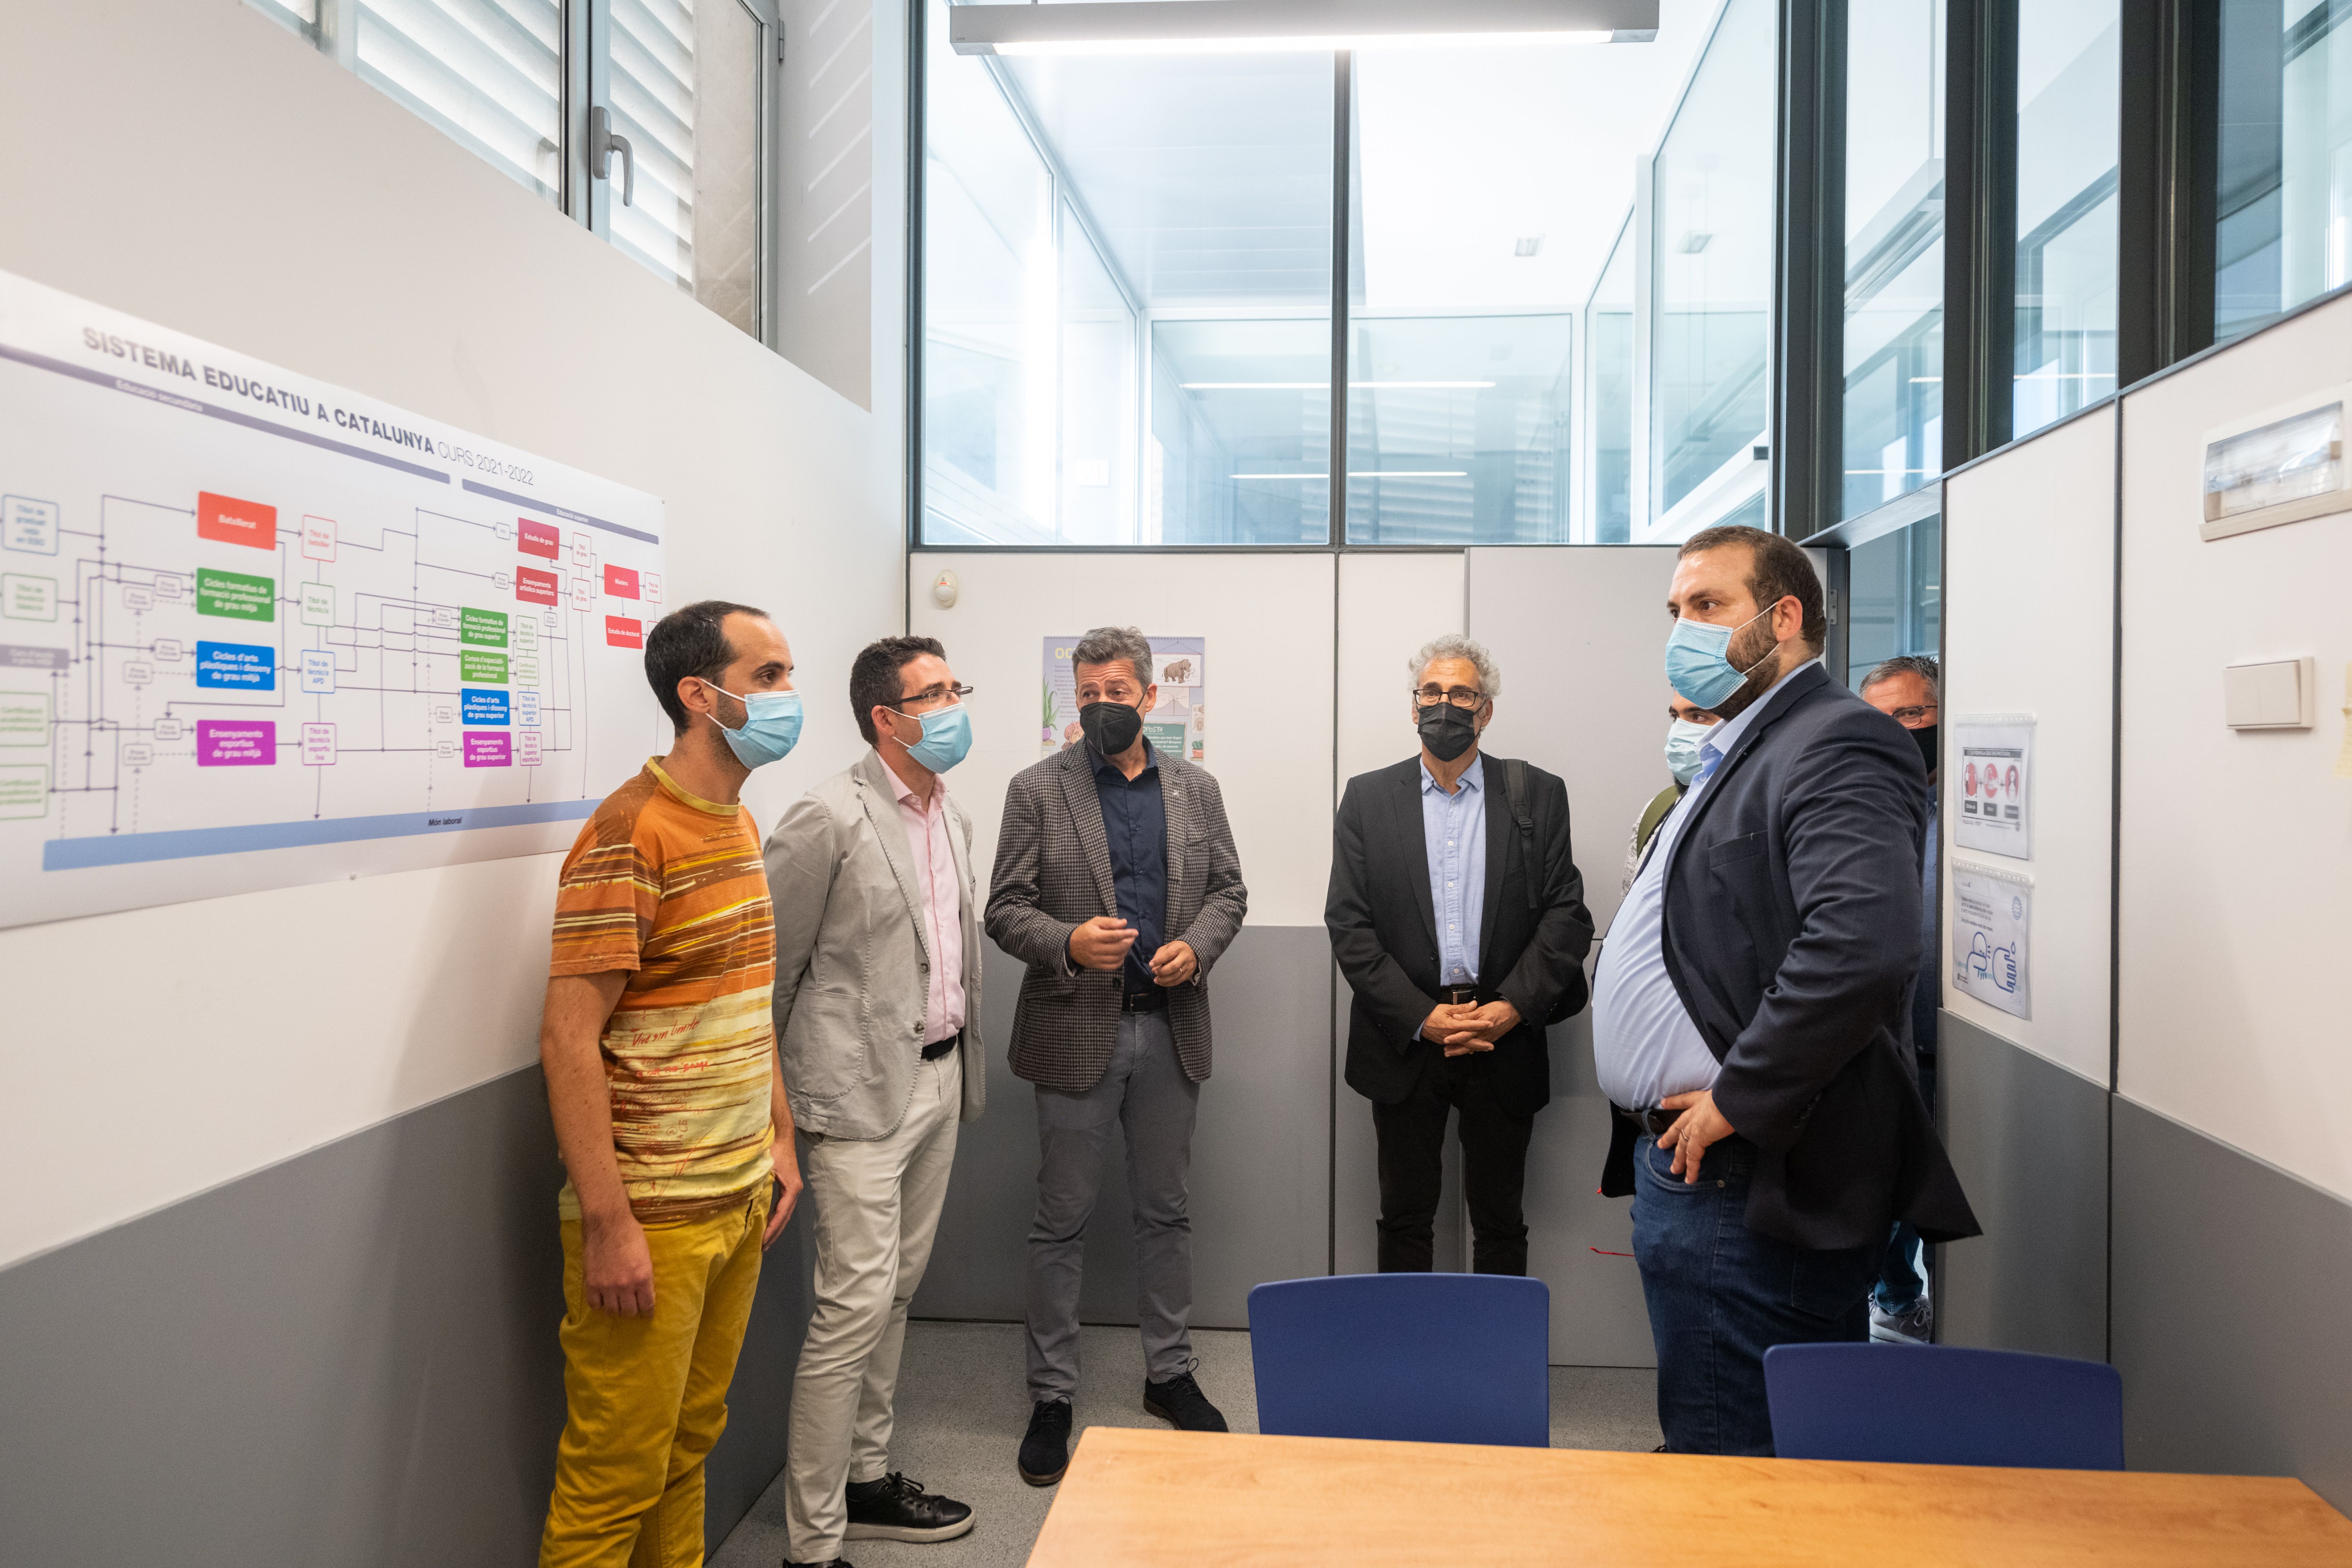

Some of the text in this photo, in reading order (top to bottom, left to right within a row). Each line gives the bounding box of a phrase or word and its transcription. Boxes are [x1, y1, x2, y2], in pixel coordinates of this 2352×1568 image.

[83, 327, 534, 485] SISTEMA EDUCATIU A CATALUNYA CURS 2021-2022
[557, 509, 574, 518] Educació
[218, 514, 256, 529] Batxillerat
[525, 533, 539, 543] Estudis
[204, 577, 225, 588] Cicles
[523, 577, 552, 588] Ensenyaments
[520, 585, 555, 596] artístics superiors
[214, 599, 224, 608] de
[212, 651, 259, 662] Cicles d'arts
[1055, 647, 1073, 659] OC
[200, 661, 238, 671] plàstiques
[243, 663, 272, 674] disseny
[211, 671, 222, 680] de
[209, 729, 264, 739] Ensenyaments
[224, 751, 242, 759] grau
[443, 816, 462, 825] laboral
[632, 1033, 651, 1046] Vive
